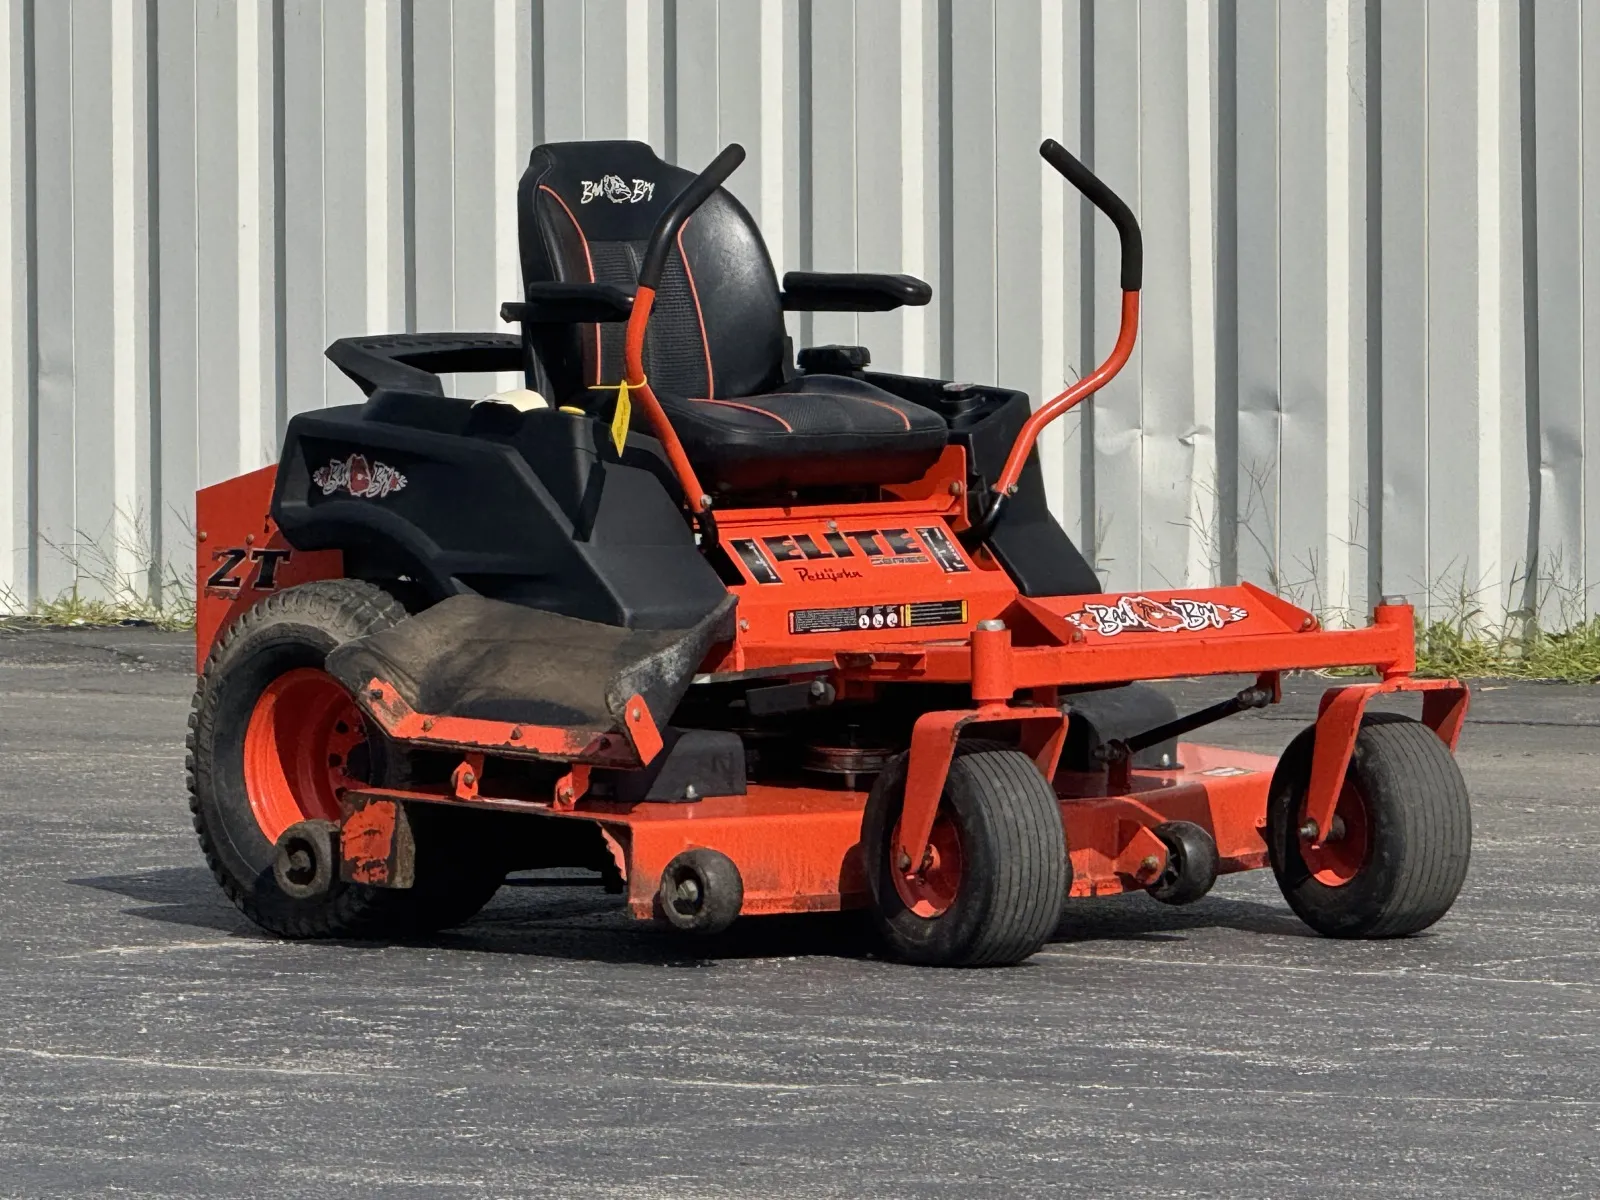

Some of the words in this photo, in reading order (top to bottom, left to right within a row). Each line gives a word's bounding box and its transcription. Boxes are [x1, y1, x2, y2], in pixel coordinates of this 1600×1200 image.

[761, 528, 922, 562] ELITE
[206, 547, 292, 592] ZT
[793, 567, 863, 582] Pettijohn
[1170, 598, 1225, 632] Boy
